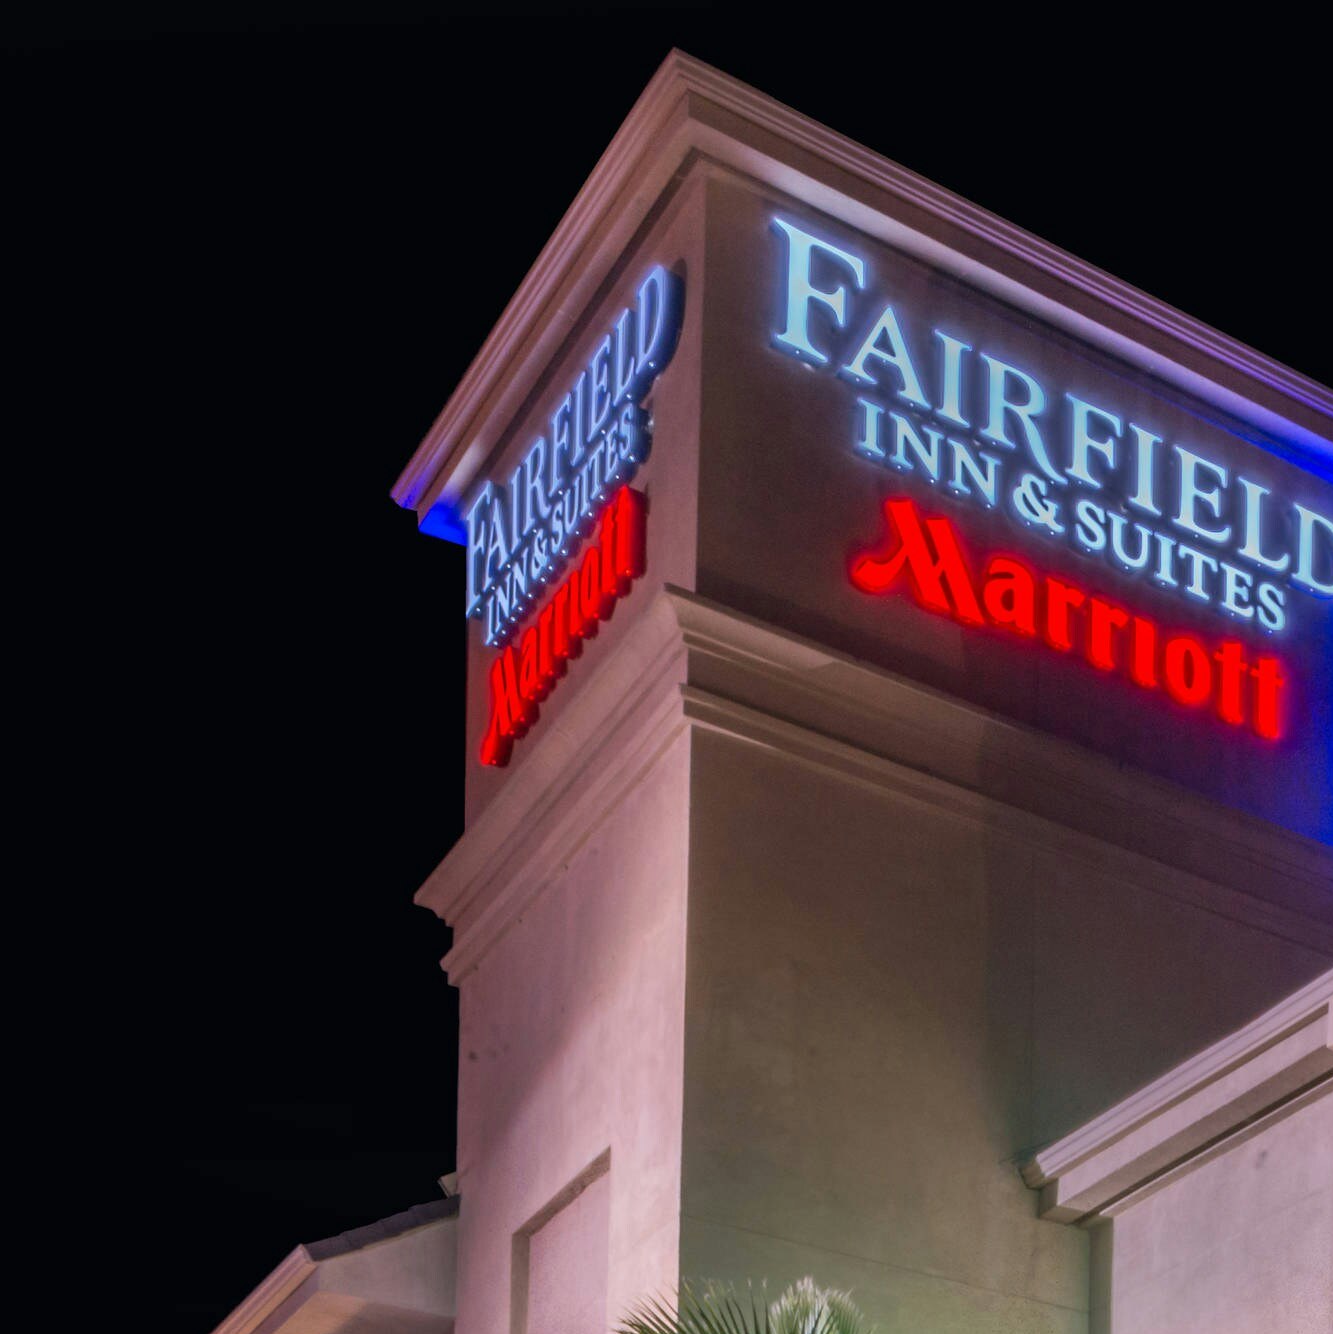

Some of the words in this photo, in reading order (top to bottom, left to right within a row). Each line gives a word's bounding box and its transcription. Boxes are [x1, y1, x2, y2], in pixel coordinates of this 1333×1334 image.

[466, 264, 666, 618] FAIRFIELD
[485, 549, 528, 646] INN
[531, 529, 549, 581] &
[551, 402, 634, 556] SUITES
[858, 398, 1000, 506] INN
[1012, 474, 1061, 534] &
[1075, 500, 1287, 634] SUITES
[480, 484, 635, 767] Marriott
[851, 499, 1286, 741] Marriott
